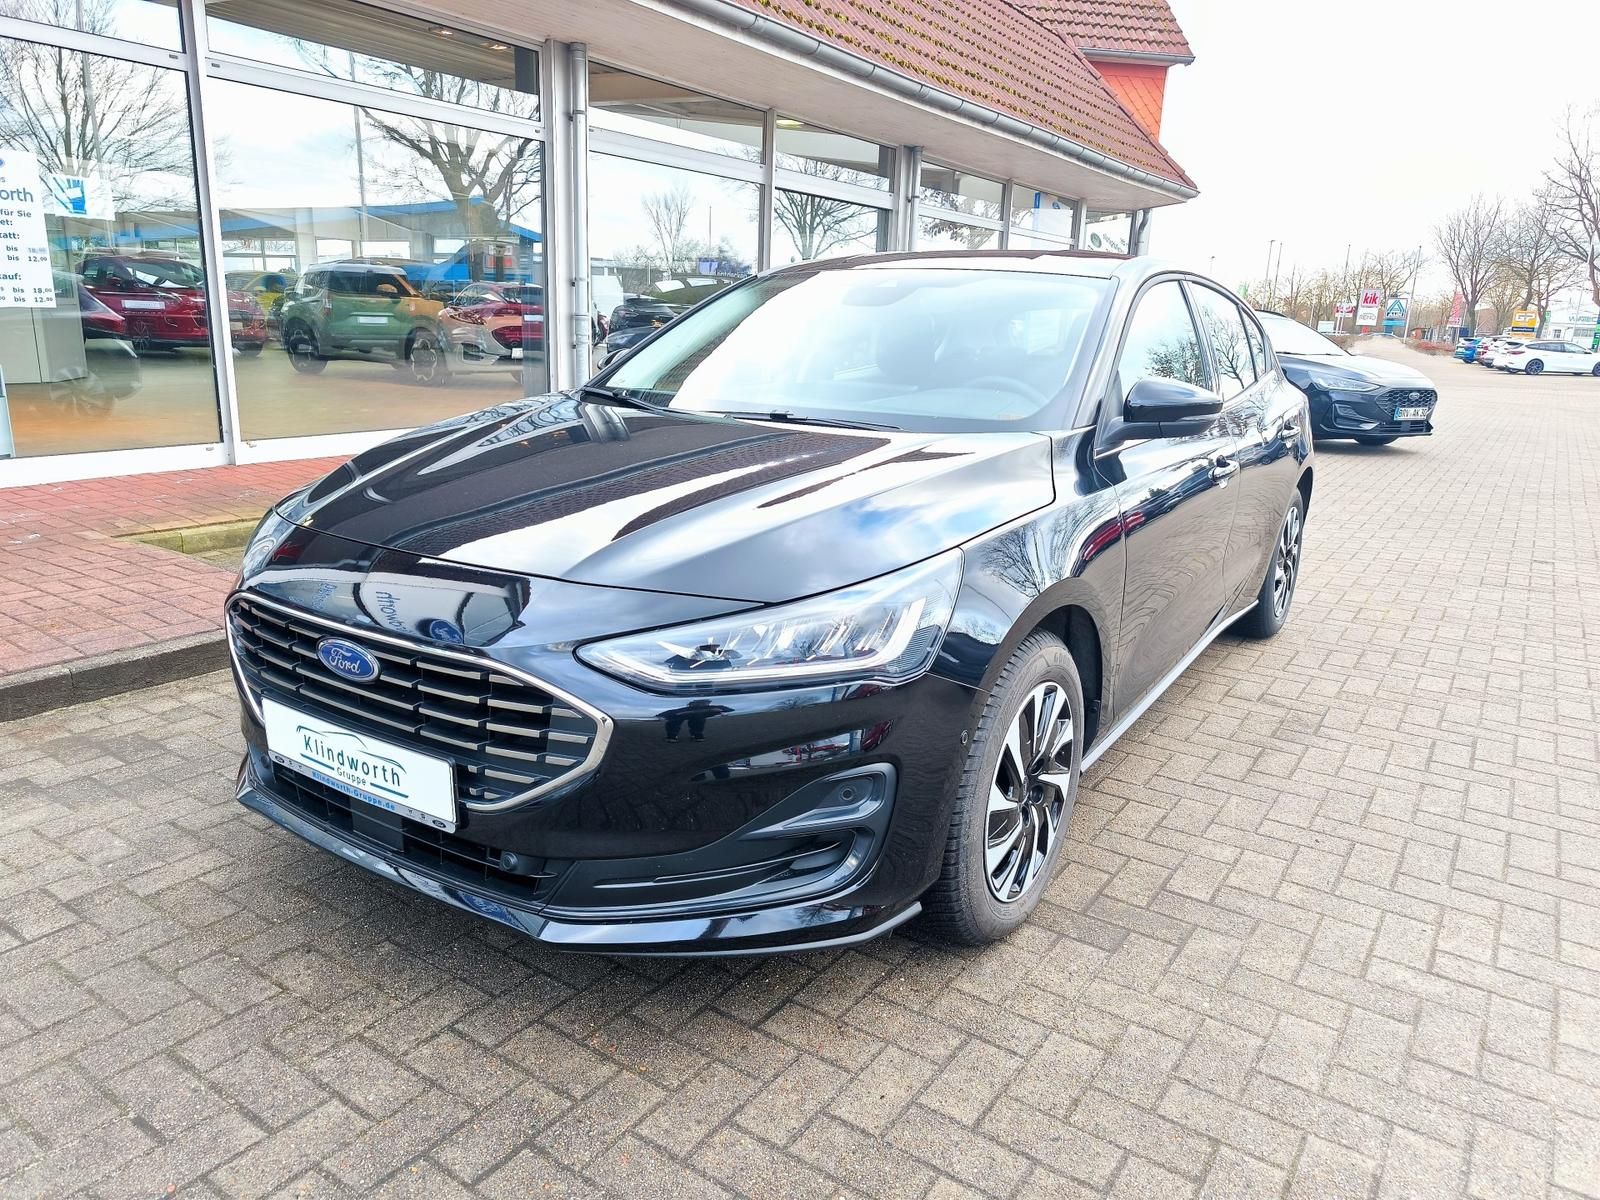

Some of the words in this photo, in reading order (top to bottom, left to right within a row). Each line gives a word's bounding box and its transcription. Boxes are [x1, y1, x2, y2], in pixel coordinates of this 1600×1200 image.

[17, 210, 32, 218] Sie
[329, 647, 361, 674] Ford
[304, 734, 400, 786] Klindworth
[336, 767, 366, 786] Gruppe
